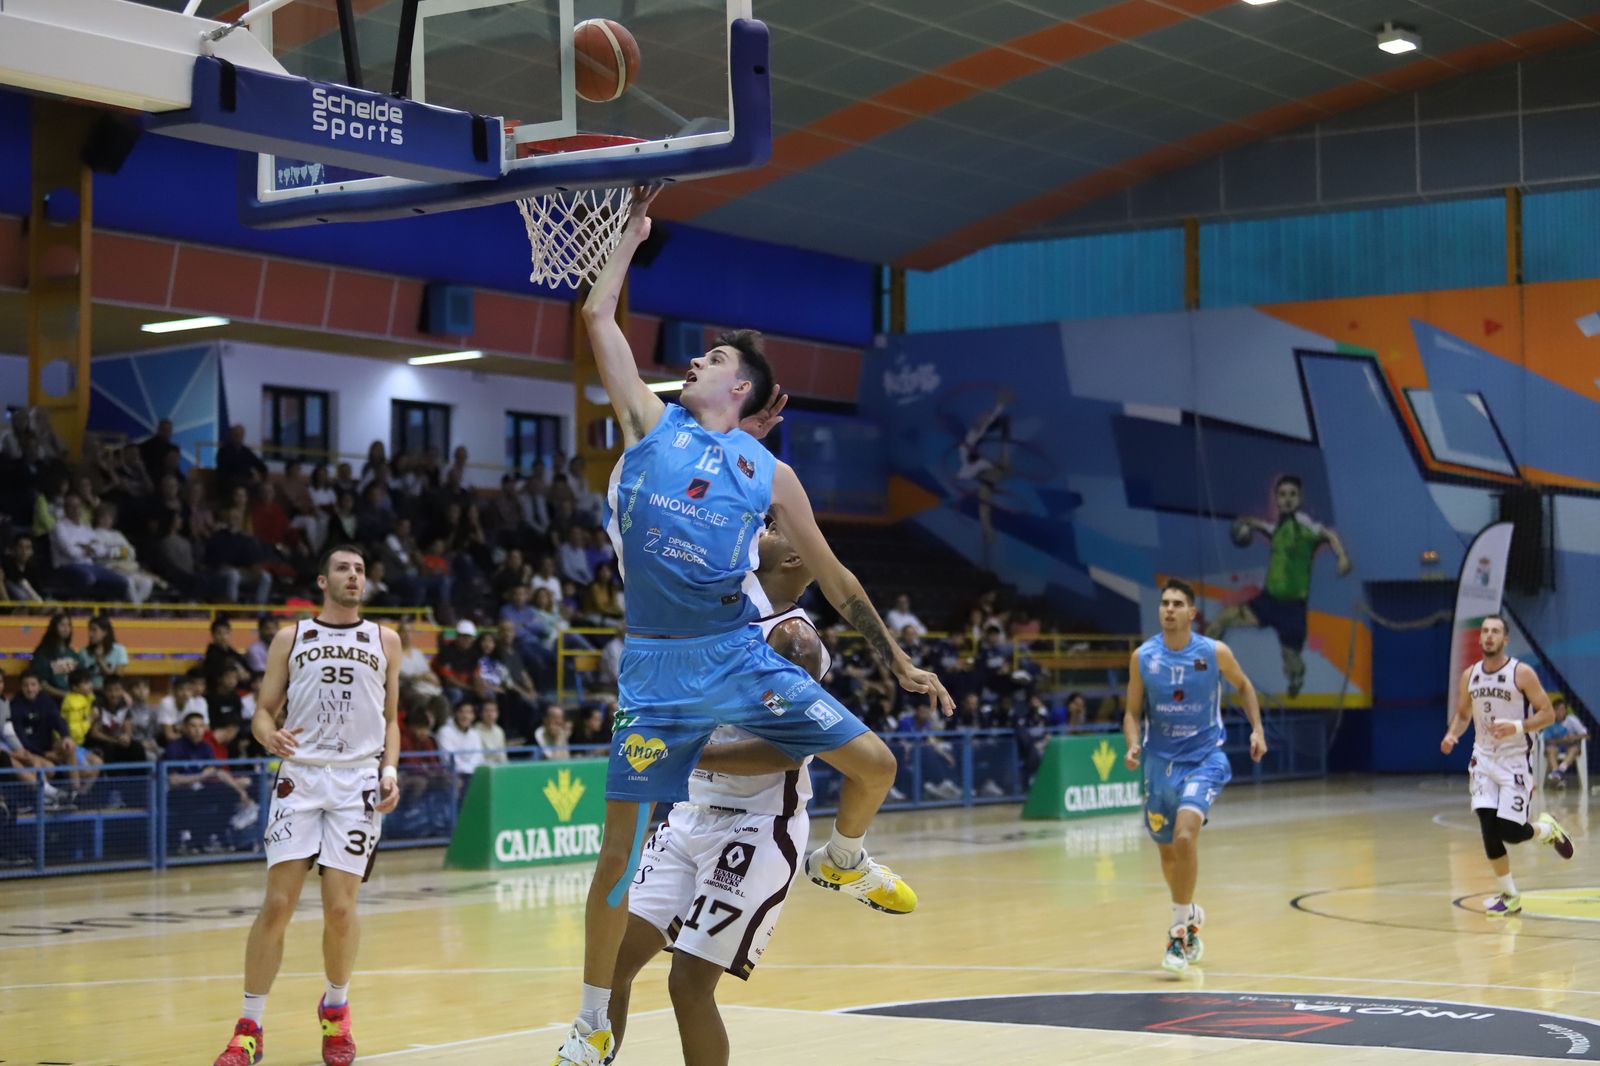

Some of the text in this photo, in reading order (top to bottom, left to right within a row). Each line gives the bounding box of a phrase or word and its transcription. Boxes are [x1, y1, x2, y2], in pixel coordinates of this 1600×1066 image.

[312, 87, 403, 125] Schelde
[312, 110, 403, 145] Sports
[695, 445, 724, 475] 12
[649, 493, 729, 527] INNOVACHEF
[295, 645, 379, 672] TORMES
[321, 666, 354, 685] 35
[1170, 666, 1184, 685] 17
[1483, 702, 1491, 713] 3
[1064, 786, 1098, 812] CAJA
[1511, 796, 1524, 812] 3
[495, 828, 551, 862] CAJA
[552, 823, 604, 857] RUR
[713, 873, 739, 888] TRUCKS
[714, 868, 744, 882] RENAULT
[684, 895, 743, 937] 17
[1295, 1003, 1495, 1020] INNOVA
